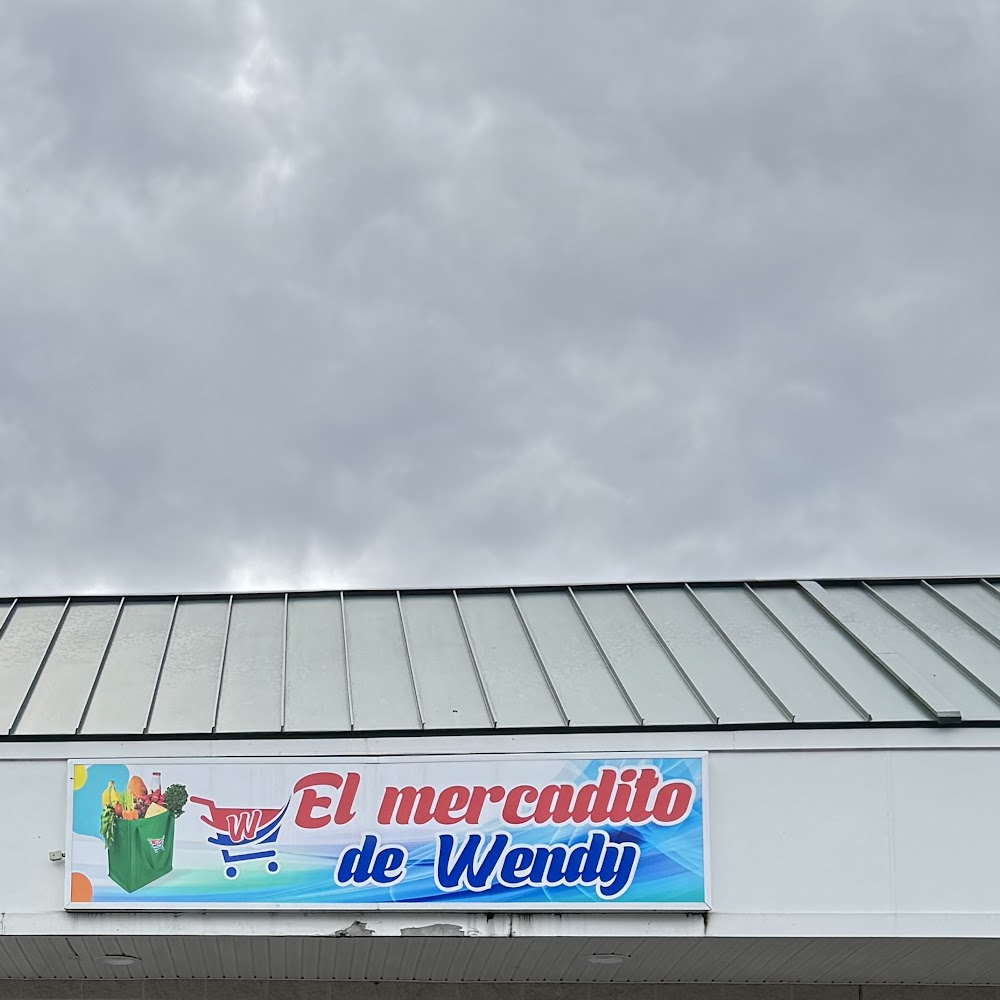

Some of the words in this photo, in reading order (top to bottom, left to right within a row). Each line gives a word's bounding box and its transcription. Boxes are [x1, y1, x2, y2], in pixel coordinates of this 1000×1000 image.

[294, 772, 359, 827] El
[380, 768, 694, 826] mercadito
[339, 835, 404, 885] de
[437, 831, 637, 897] Wendy
